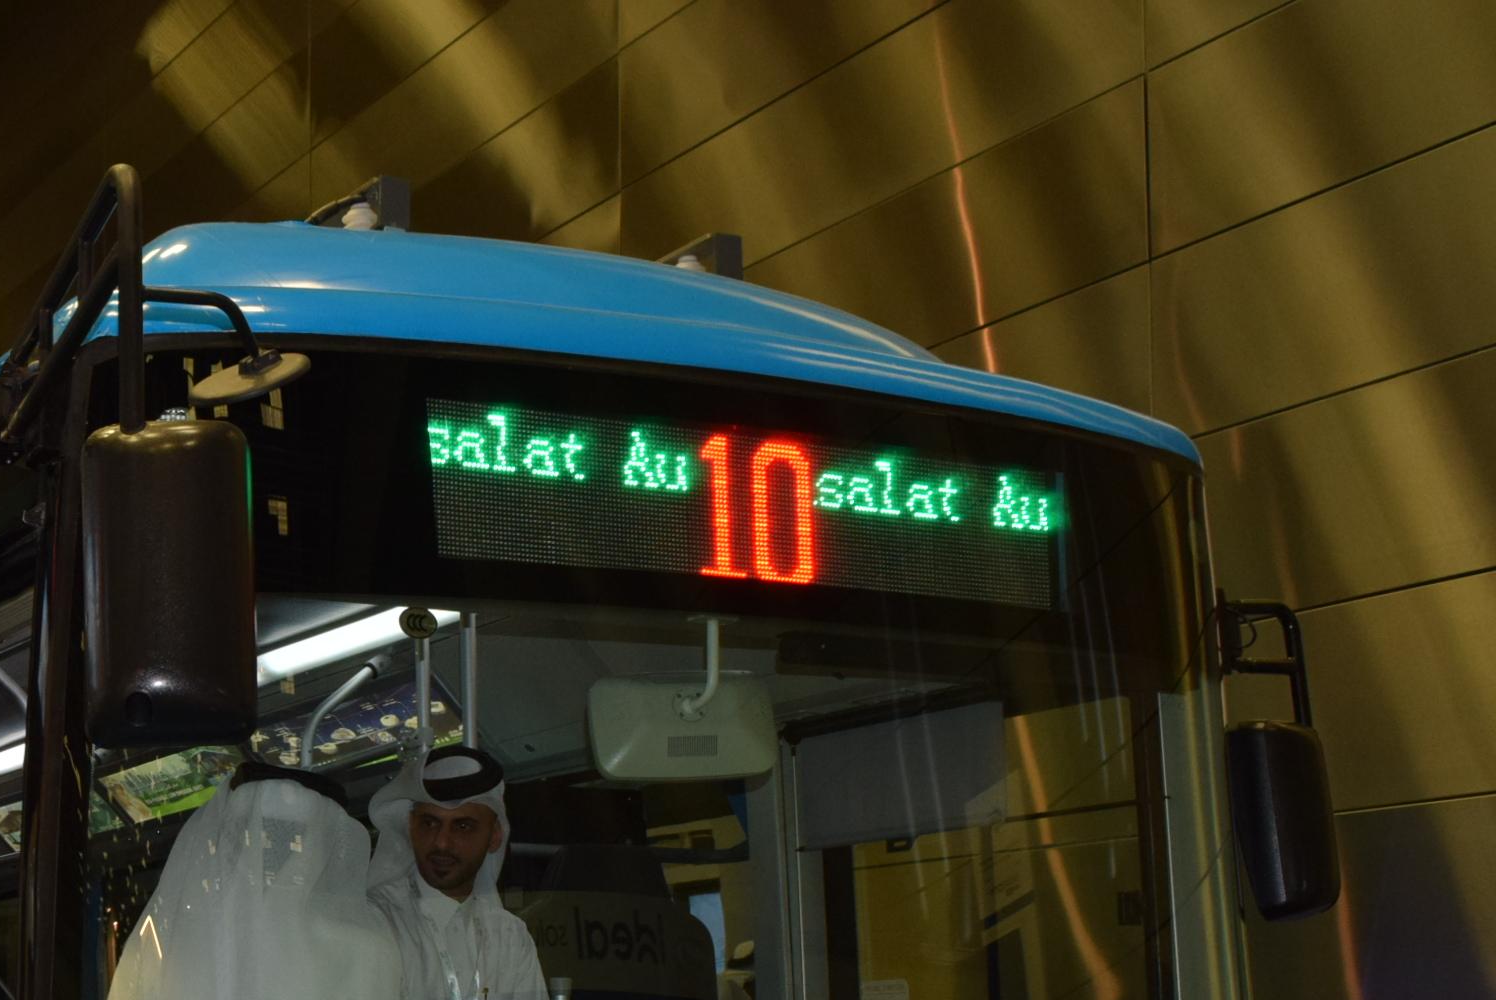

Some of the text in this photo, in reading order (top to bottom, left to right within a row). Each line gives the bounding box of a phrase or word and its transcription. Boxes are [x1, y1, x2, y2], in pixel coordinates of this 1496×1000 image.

[426, 412, 689, 492] salat Au
[700, 434, 815, 585] 10
[812, 459, 1050, 532] salat Au
